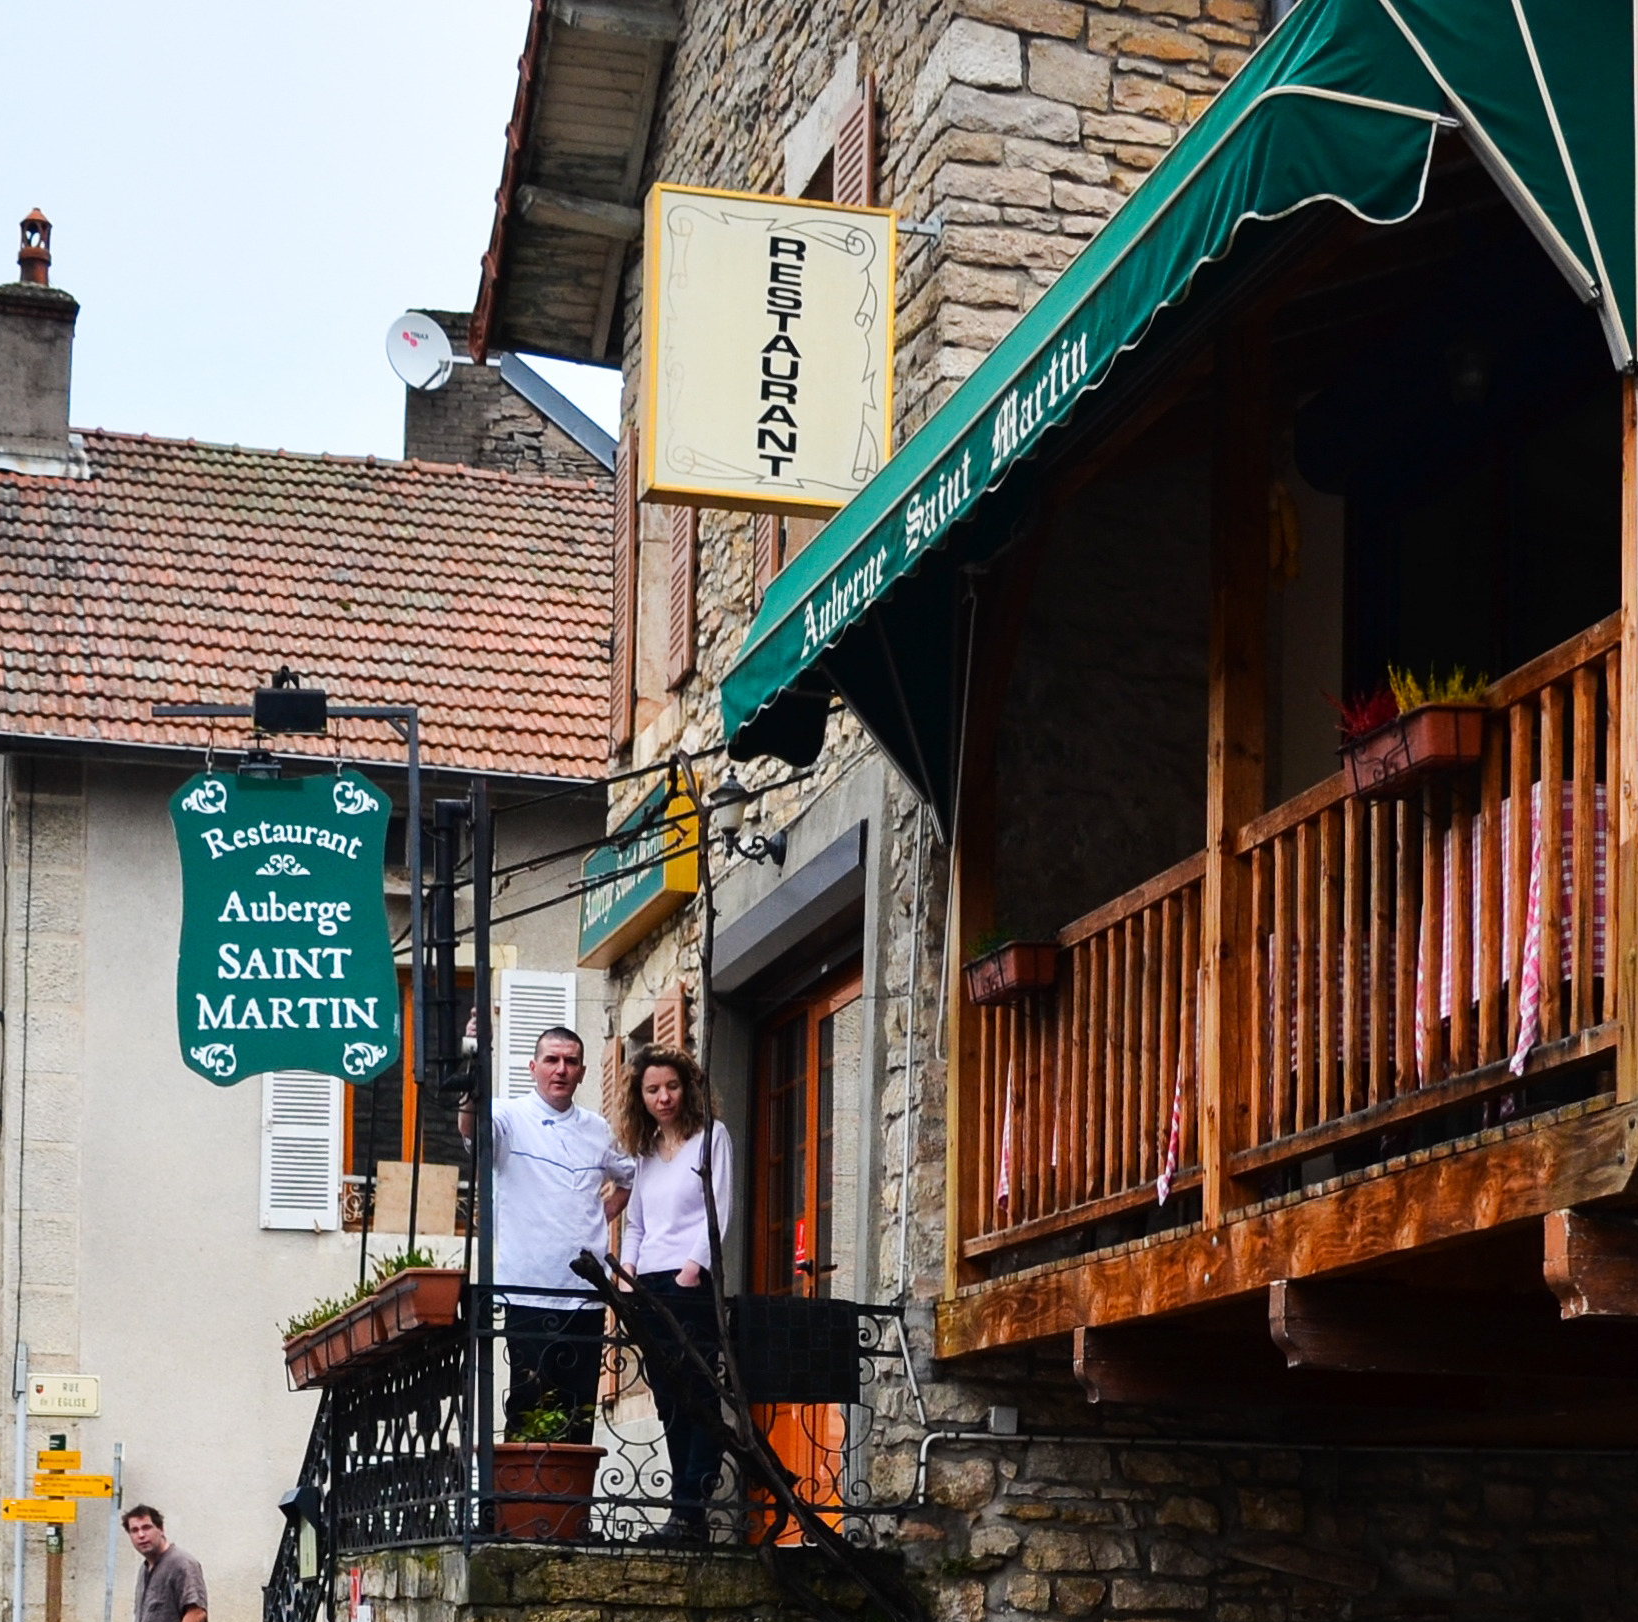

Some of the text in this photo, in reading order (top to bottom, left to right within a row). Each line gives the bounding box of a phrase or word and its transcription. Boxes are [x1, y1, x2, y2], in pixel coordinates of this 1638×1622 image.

[757, 236, 807, 477] RESTAURANT
[801, 332, 1088, 660] Auberge Saint Martin
[201, 821, 362, 860] Restaurant
[218, 891, 351, 936] Auberge
[218, 943, 352, 979] SAINT
[196, 994, 379, 1030] MARTIN
[62, 1382, 80, 1393] RUE
